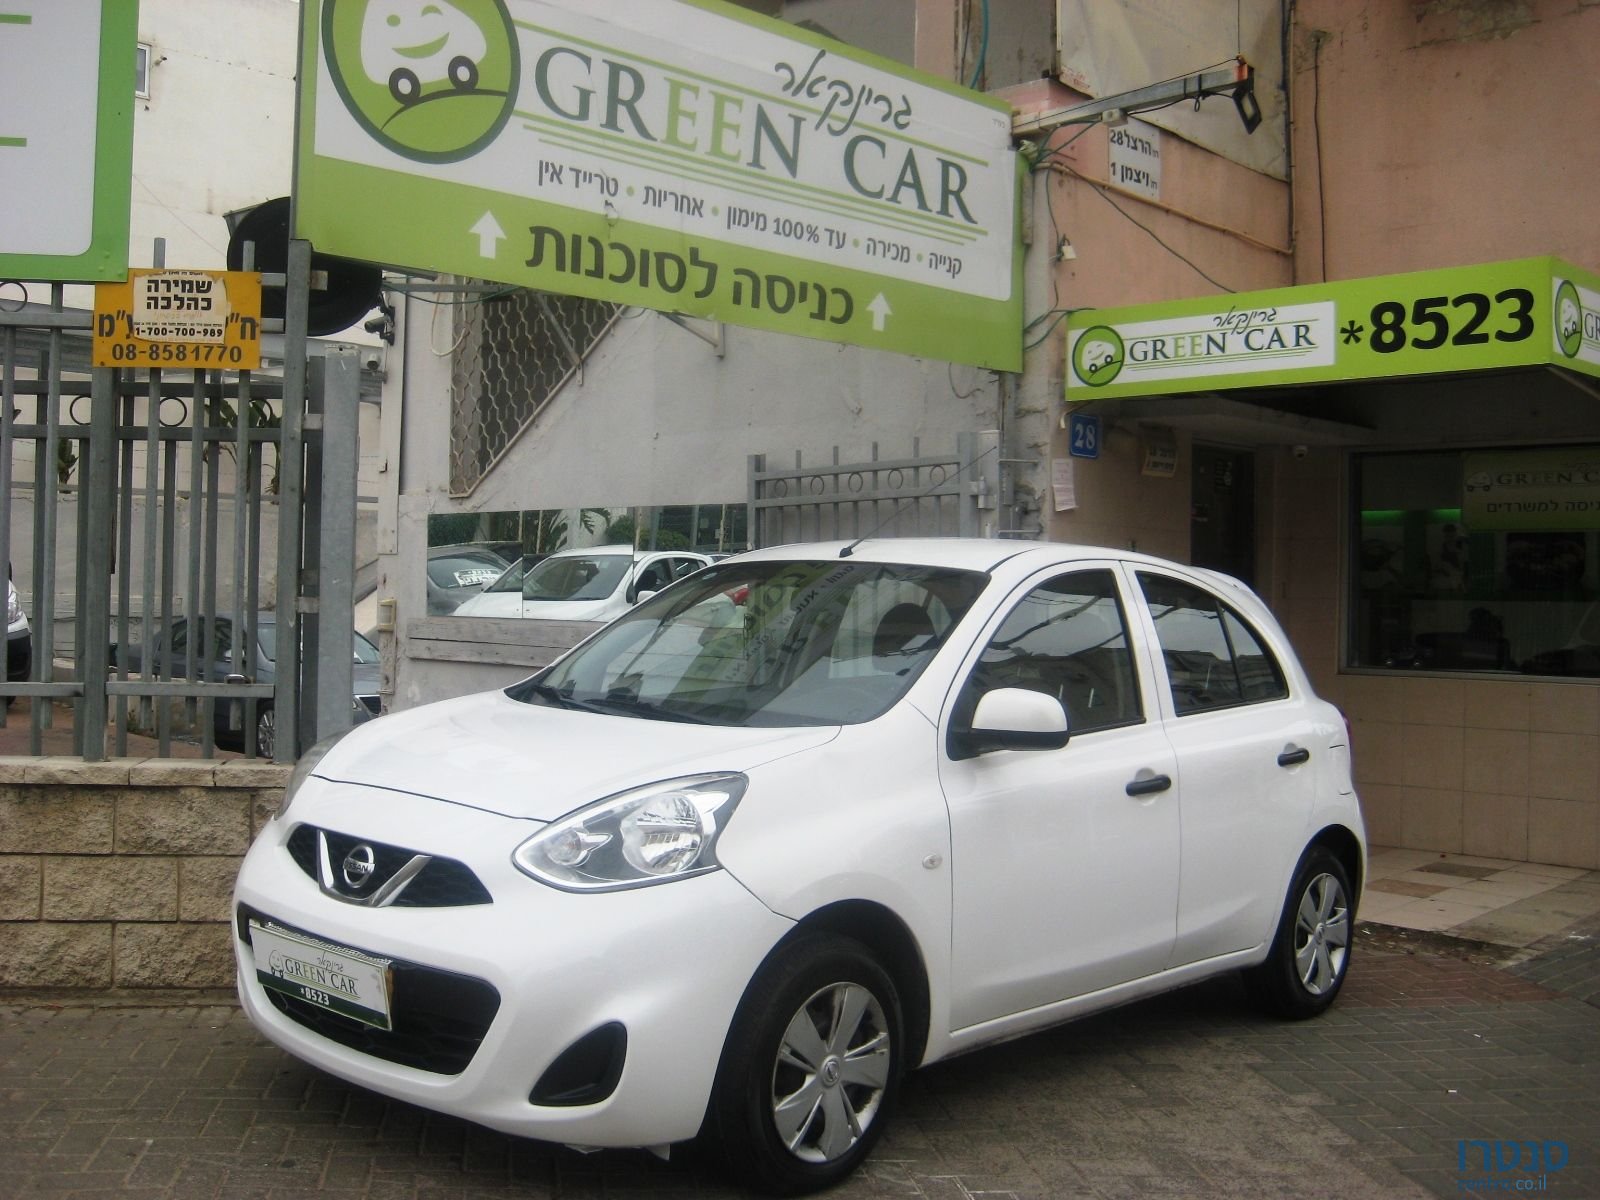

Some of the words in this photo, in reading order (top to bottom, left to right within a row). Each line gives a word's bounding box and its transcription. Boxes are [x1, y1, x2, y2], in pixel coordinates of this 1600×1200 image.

[774, 49, 912, 136] גרינקאר
[535, 47, 806, 178] GREEN
[843, 134, 978, 224] CAR
[538, 160, 563, 186] אין
[569, 167, 619, 197] טרייד
[1110, 162, 1116, 176] 1
[1121, 165, 1149, 187] ויצמן
[642, 186, 704, 218] אחריות
[727, 206, 767, 231] מימון
[773, 218, 819, 243] 100%
[824, 227, 846, 249] עד
[866, 238, 910, 263] מכירה
[525, 226, 718, 298] לסוכנות
[928, 252, 962, 279] קנייה
[147, 279, 213, 293] שמירה
[732, 267, 854, 324] כניסה
[146, 294, 212, 310] כהלכה
[135, 327, 223, 337] 1-700-700-989
[1213, 305, 1277, 335] גרינקאר
[112, 343, 242, 363] 08-8581770
[1129, 331, 1228, 362] GREEN
[1244, 324, 1316, 351] CAR
[1074, 423, 1096, 450] 28
[285, 958, 326, 984] GREEN
[330, 973, 358, 995] CAR
